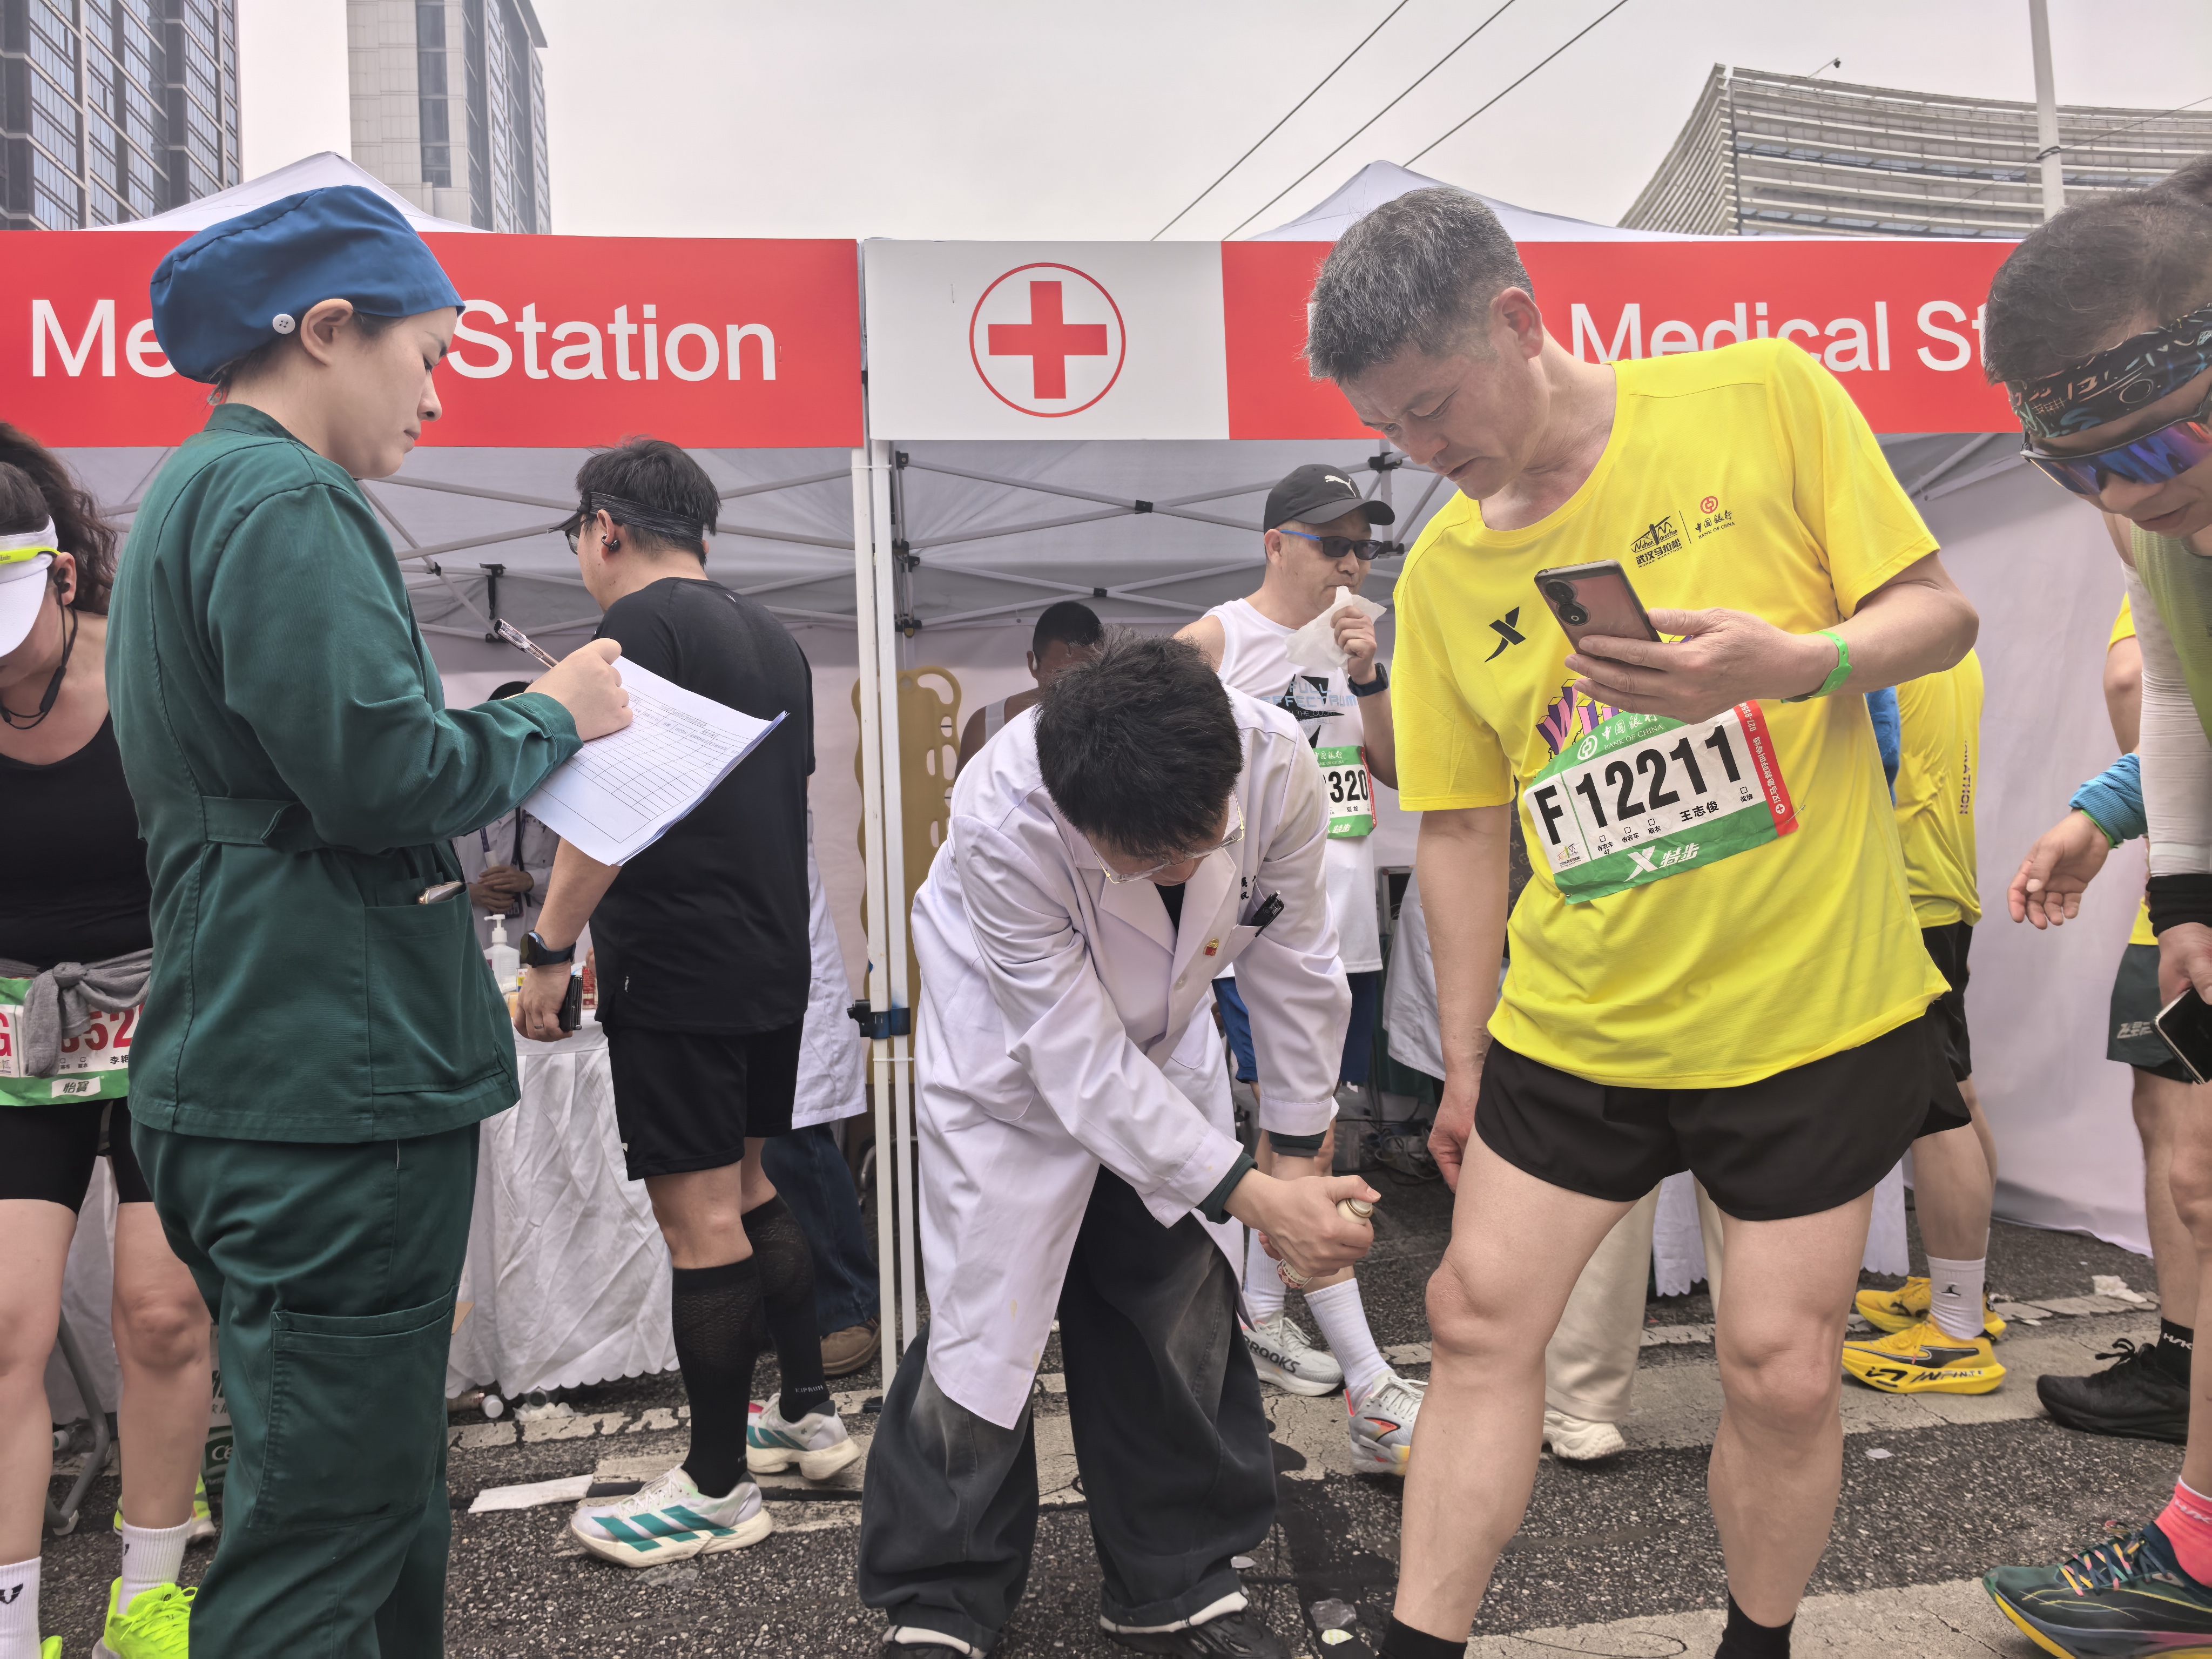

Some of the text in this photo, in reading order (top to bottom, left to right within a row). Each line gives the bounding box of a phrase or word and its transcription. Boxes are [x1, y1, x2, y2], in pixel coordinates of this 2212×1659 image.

[448, 299, 776, 382] Station
[1698, 530, 1712, 539] BANK
[1635, 538, 1682, 565] 武汉马拉松
[1638, 546, 1683, 568] WUHAN MARATHON
[1290, 681, 1331, 693] FULL
[1604, 724, 1664, 750] BANK OF CHINA
[1323, 769, 1368, 803] 320
[1534, 725, 1741, 846] F 12211
[1740, 793, 1753, 802] 奖牌
[1679, 801, 1719, 822] 王志俊
[1622, 833, 1640, 843] 收容车
[1648, 826, 1661, 834] 取衣
[1597, 841, 1614, 852] 存衣车
[62, 1004, 145, 1053] 52
